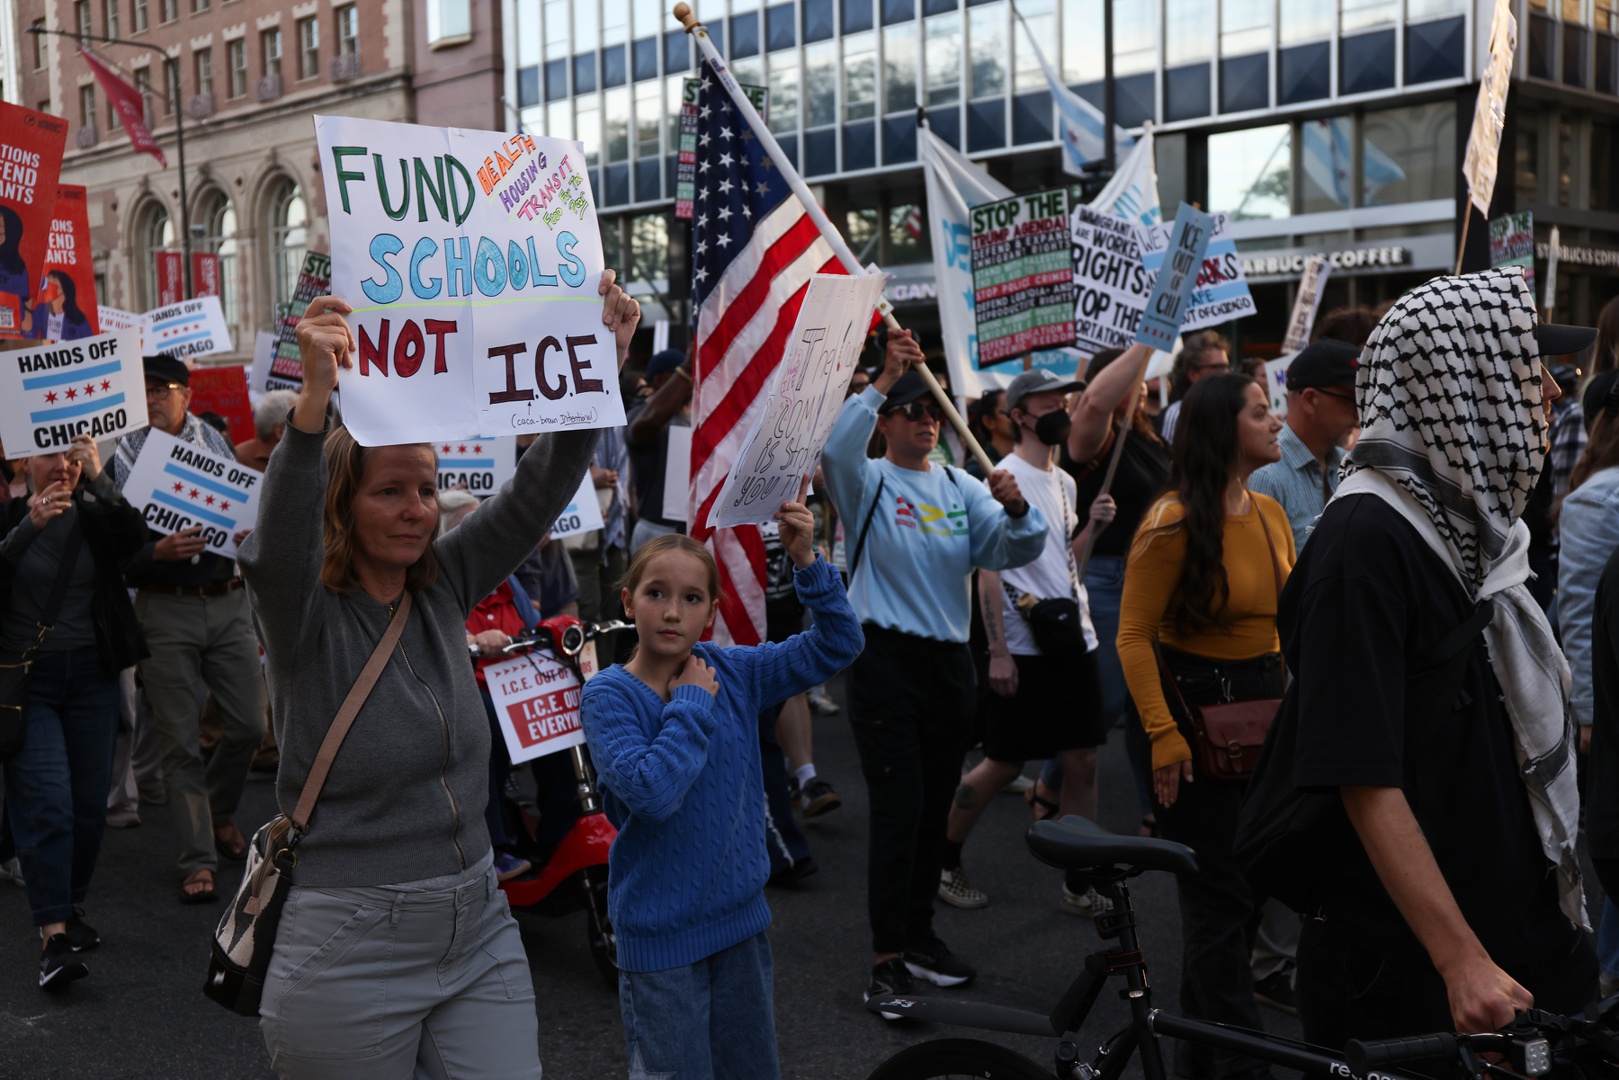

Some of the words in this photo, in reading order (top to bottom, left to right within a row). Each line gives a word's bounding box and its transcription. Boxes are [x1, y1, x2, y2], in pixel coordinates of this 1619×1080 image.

[477, 134, 537, 196] HEALTH
[331, 146, 475, 227] FUND
[499, 151, 547, 213] HOUSING
[517, 154, 573, 221] TRANSIT
[50, 218, 73, 233] ONS
[973, 201, 1020, 233] STOP
[1024, 192, 1064, 221] THE
[1079, 207, 1131, 237] IMMIGRANT
[973, 228, 1009, 248] TRUMP
[1013, 214, 1066, 238] AGENDA!
[973, 242, 1010, 259] DEFEND
[1025, 229, 1070, 246] EXPAND
[1031, 238, 1070, 255] RIGHTS
[1180, 222, 1203, 254] ICE
[45, 249, 76, 265] ANTS
[361, 231, 586, 305] SCHOOLS
[1242, 252, 1327, 274] ARBUC
[1329, 246, 1404, 268] COFFEE
[300, 272, 329, 290] TRUMP
[976, 287, 998, 301] STOP
[1034, 268, 1071, 286] CRIMES
[976, 296, 1008, 313] DEFEND
[1052, 281, 1073, 294] AND
[184, 301, 203, 314] OFF
[1073, 283, 1111, 320] TOP
[1113, 301, 1144, 333] THE
[1187, 288, 1215, 308] AFE
[358, 318, 458, 378] NOT
[1032, 327, 1074, 350] REEDOM
[17, 346, 85, 373] HANDS
[88, 339, 118, 360] OFF
[488, 334, 609, 405] I.C.E.
[33, 408, 127, 448] CHICAGO
[170, 445, 225, 477] HANDS
[227, 468, 257, 489] OFF
[502, 677, 533, 696] I.C.E.
[534, 669, 557, 686] OUT
[522, 694, 563, 720] I.C.E.
[527, 710, 581, 741] EVERYW
